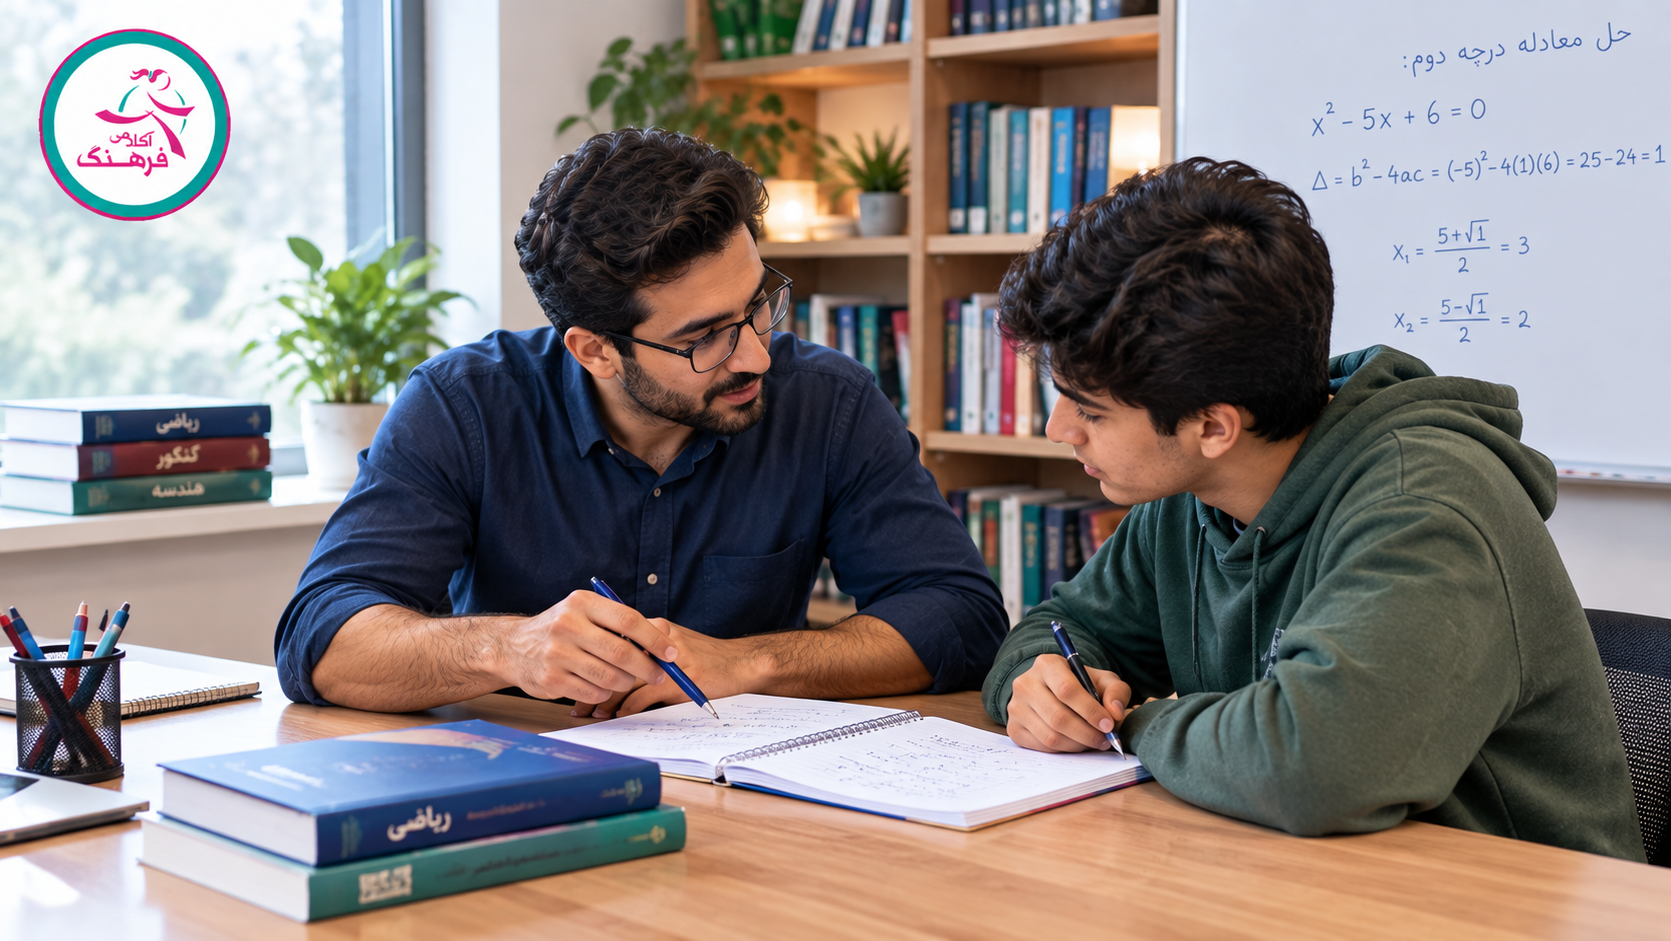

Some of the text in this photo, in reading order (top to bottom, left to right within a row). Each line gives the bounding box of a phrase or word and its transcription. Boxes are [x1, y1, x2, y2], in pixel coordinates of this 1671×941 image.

[1518, 29, 1583, 53] معادله
[1596, 22, 1632, 53] حل
[1402, 50, 1447, 78] دوم:
[1363, 108, 1392, 131] 5x
[1403, 110, 1416, 125] +
[1427, 100, 1441, 125] 6
[1451, 107, 1462, 117] =
[1470, 98, 1487, 120] 0
[1654, 145, 1667, 164] 1
[1518, 235, 1530, 256] 3
[1457, 256, 1470, 274] 2
[1518, 310, 1532, 329] 2
[1459, 326, 1472, 344] 2
[156, 412, 200, 434] ریاضی
[152, 481, 205, 498] هندسه
[387, 805, 452, 842] ریاضی
